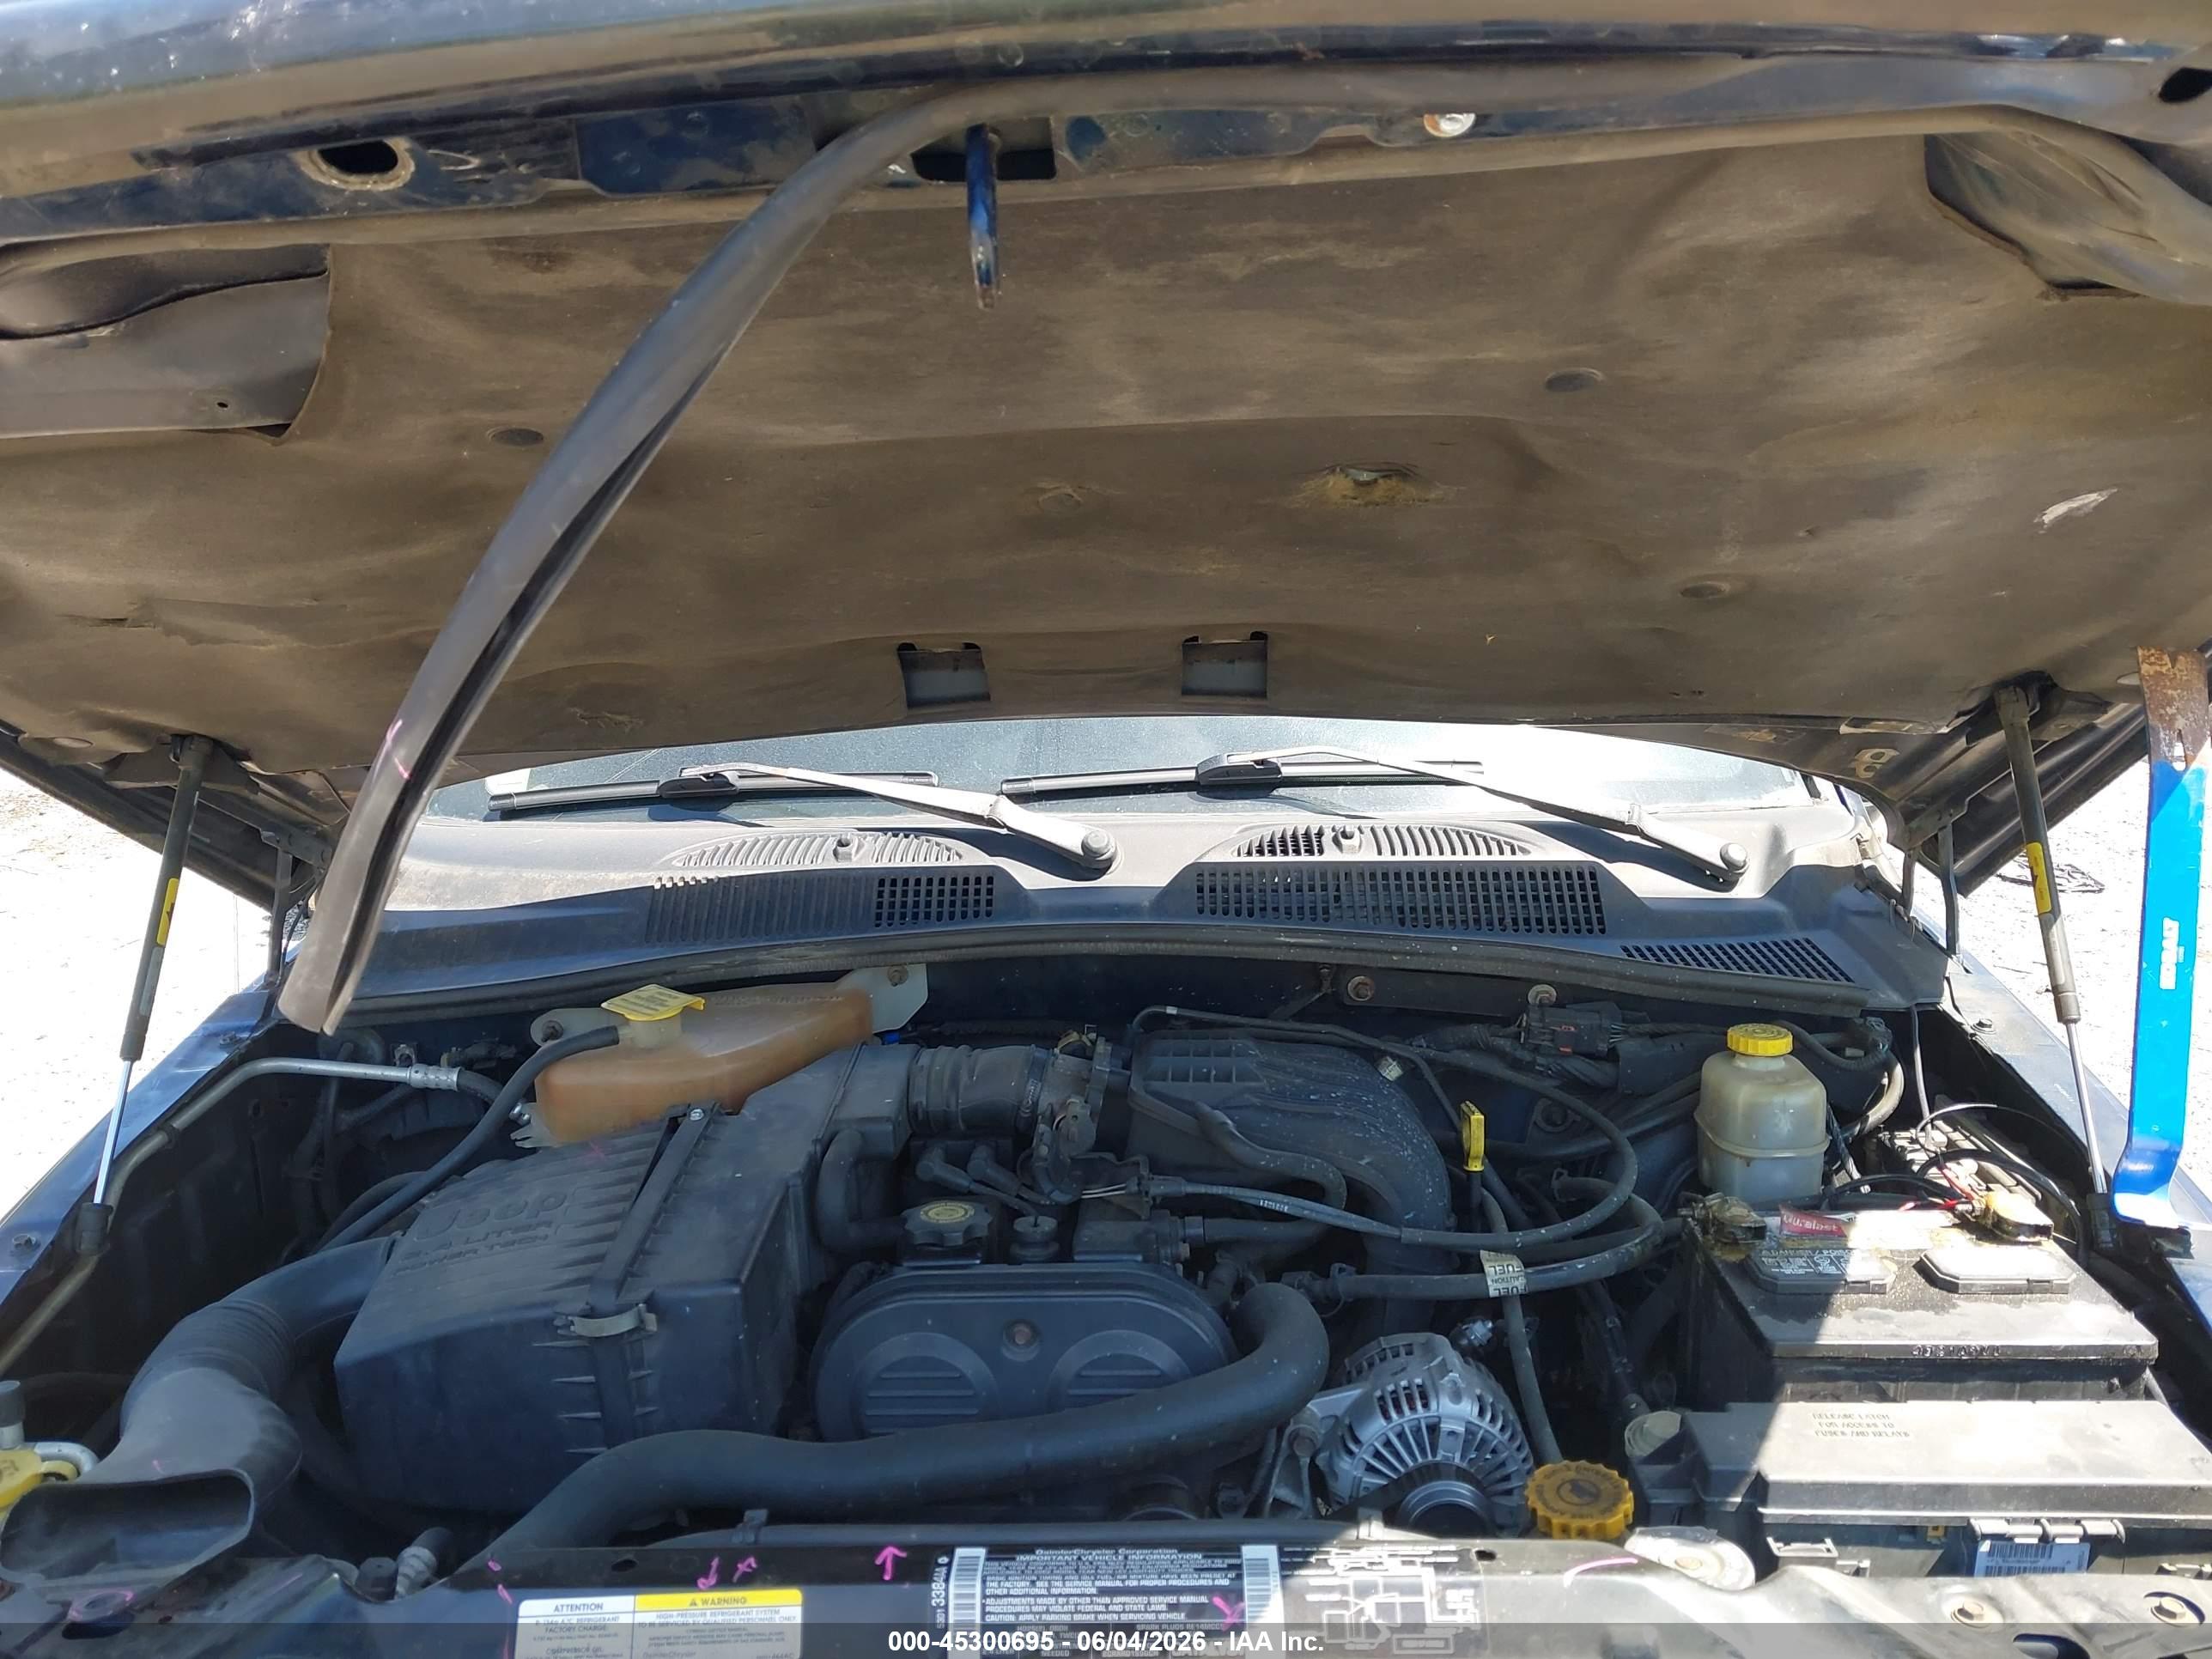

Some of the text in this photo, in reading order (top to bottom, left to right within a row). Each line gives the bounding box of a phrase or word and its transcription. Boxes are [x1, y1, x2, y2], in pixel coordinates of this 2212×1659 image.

[1489, 1264, 1523, 1276] FUEL
[1493, 1286, 1528, 1296] FUEL
[702, 1596, 747, 1606] WARNING
[554, 1602, 603, 1613] ATTENTION
